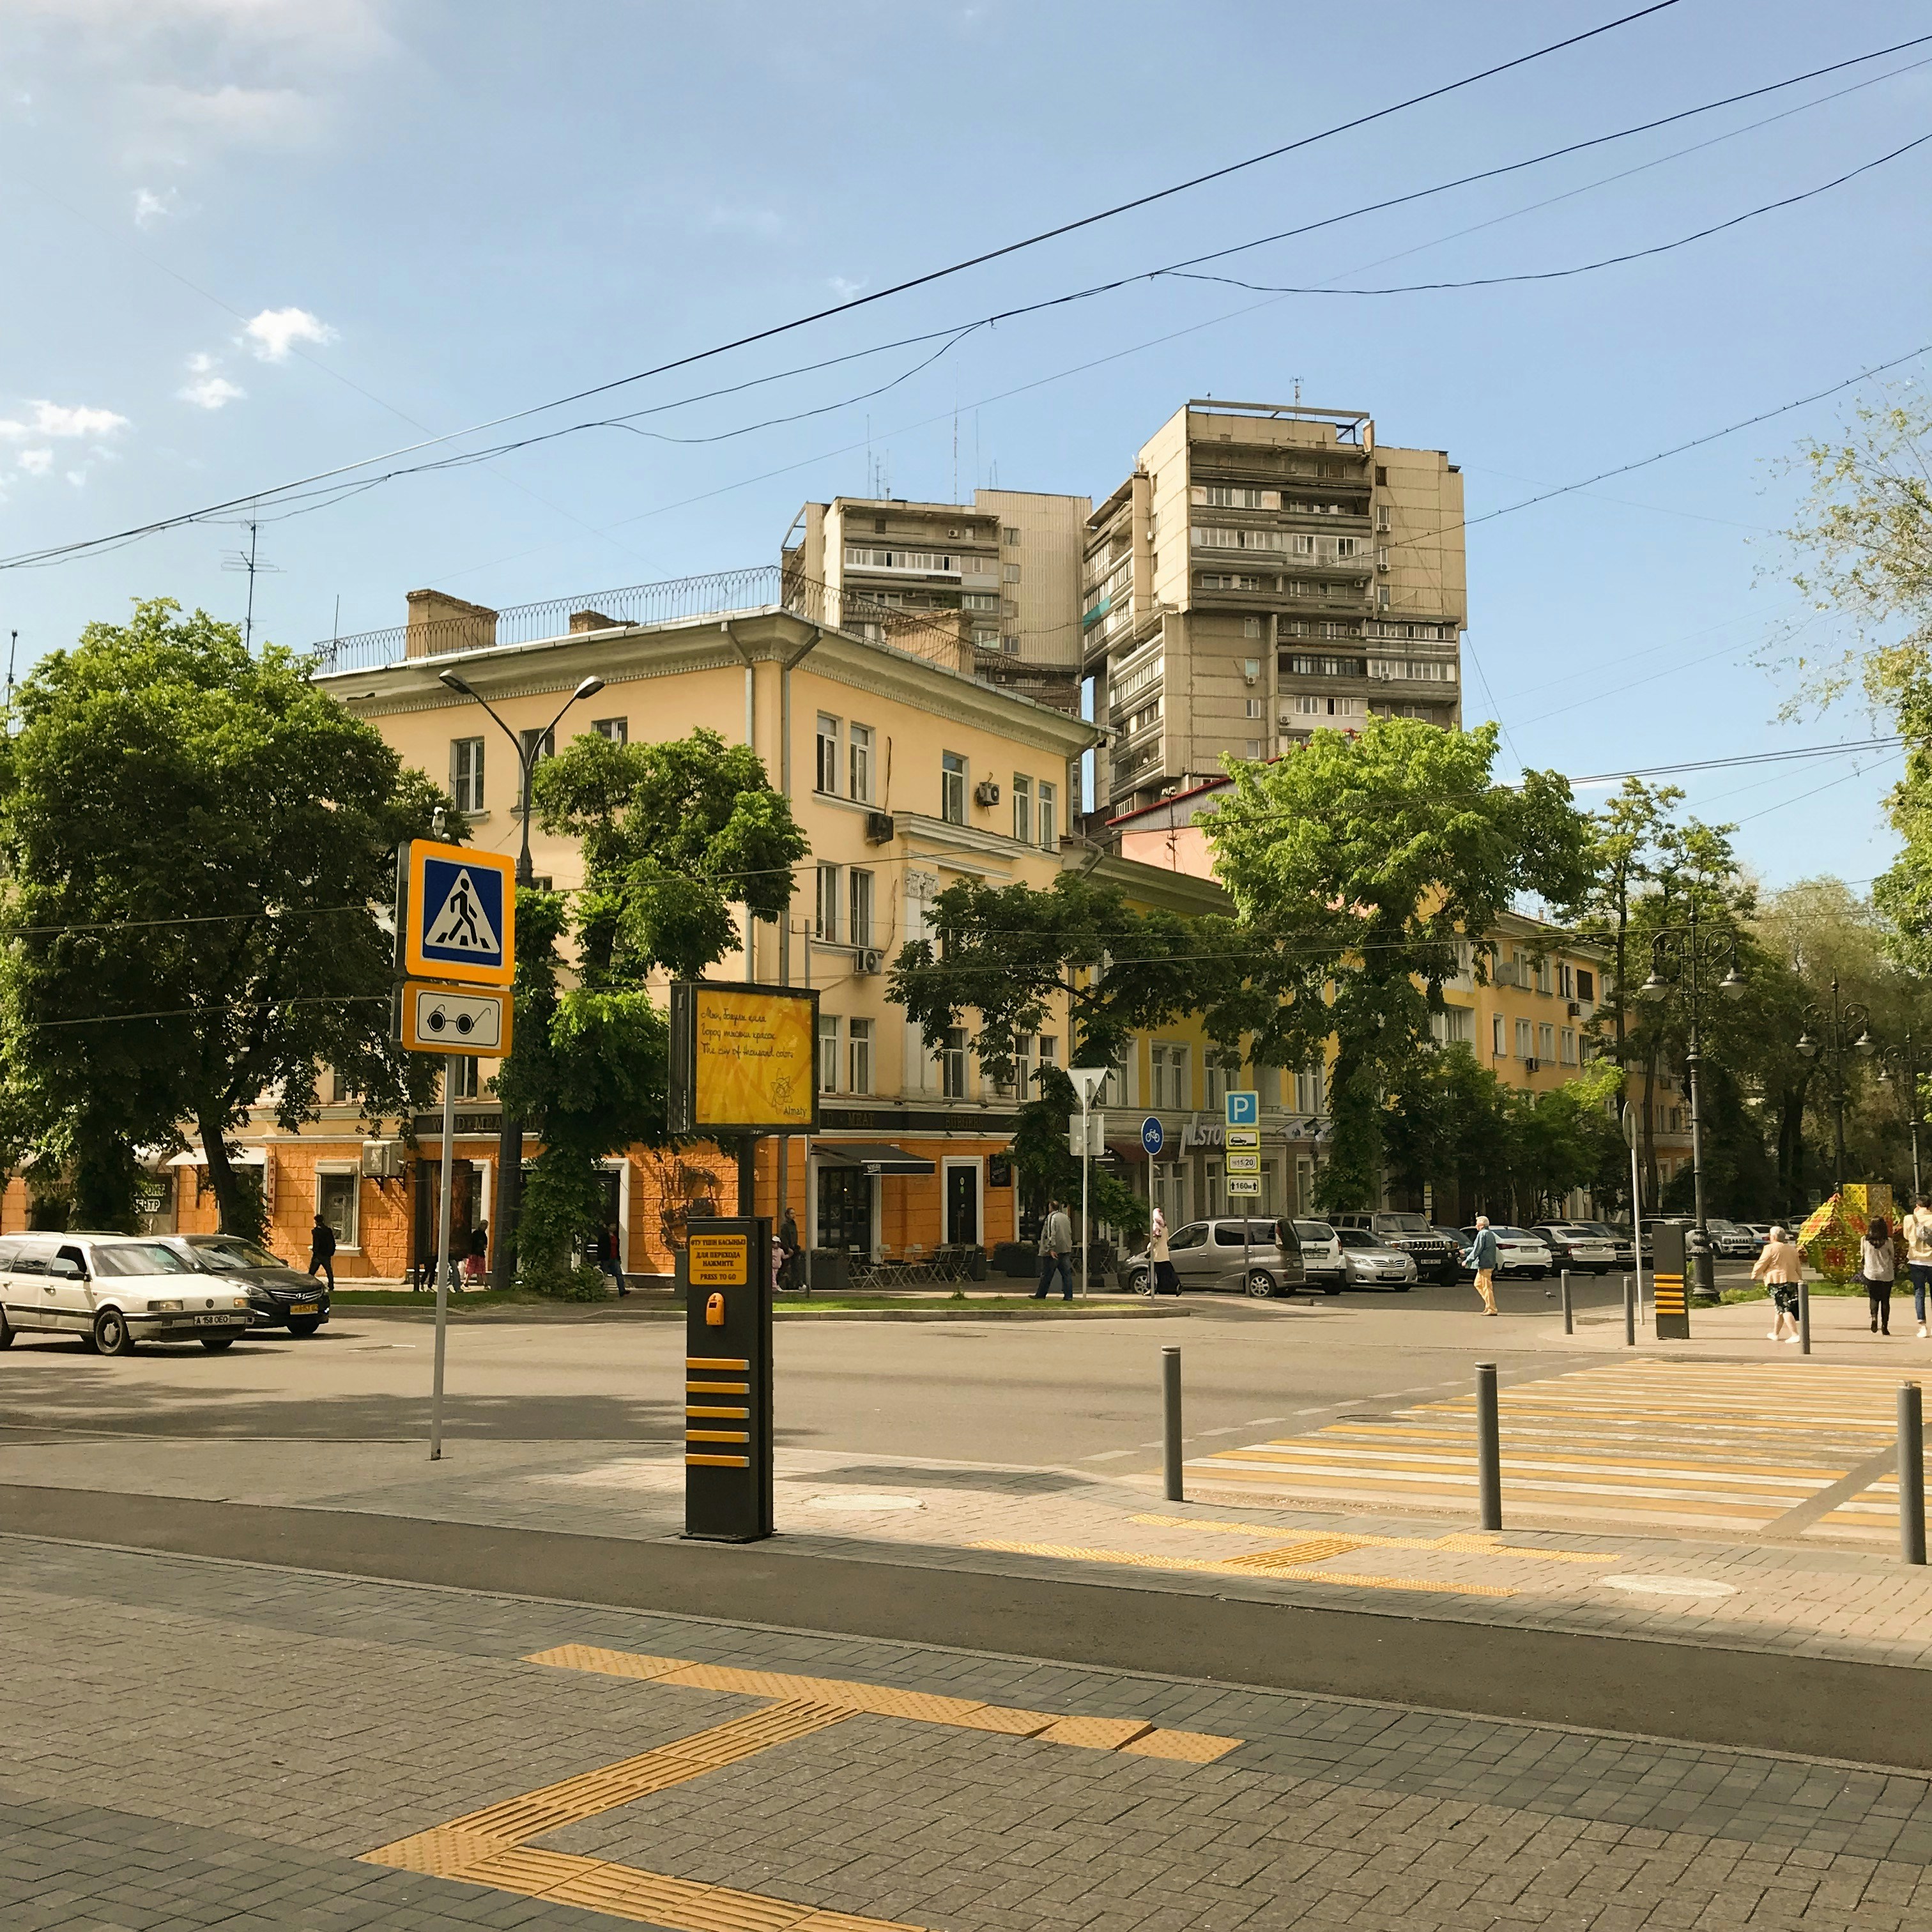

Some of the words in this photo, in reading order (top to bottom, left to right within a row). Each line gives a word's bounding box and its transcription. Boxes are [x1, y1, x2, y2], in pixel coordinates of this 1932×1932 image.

[700, 1041, 715, 1054] The
[733, 1045, 742, 1059] of
[783, 1105, 808, 1119] Almaty
[1234, 1096, 1249, 1121] P
